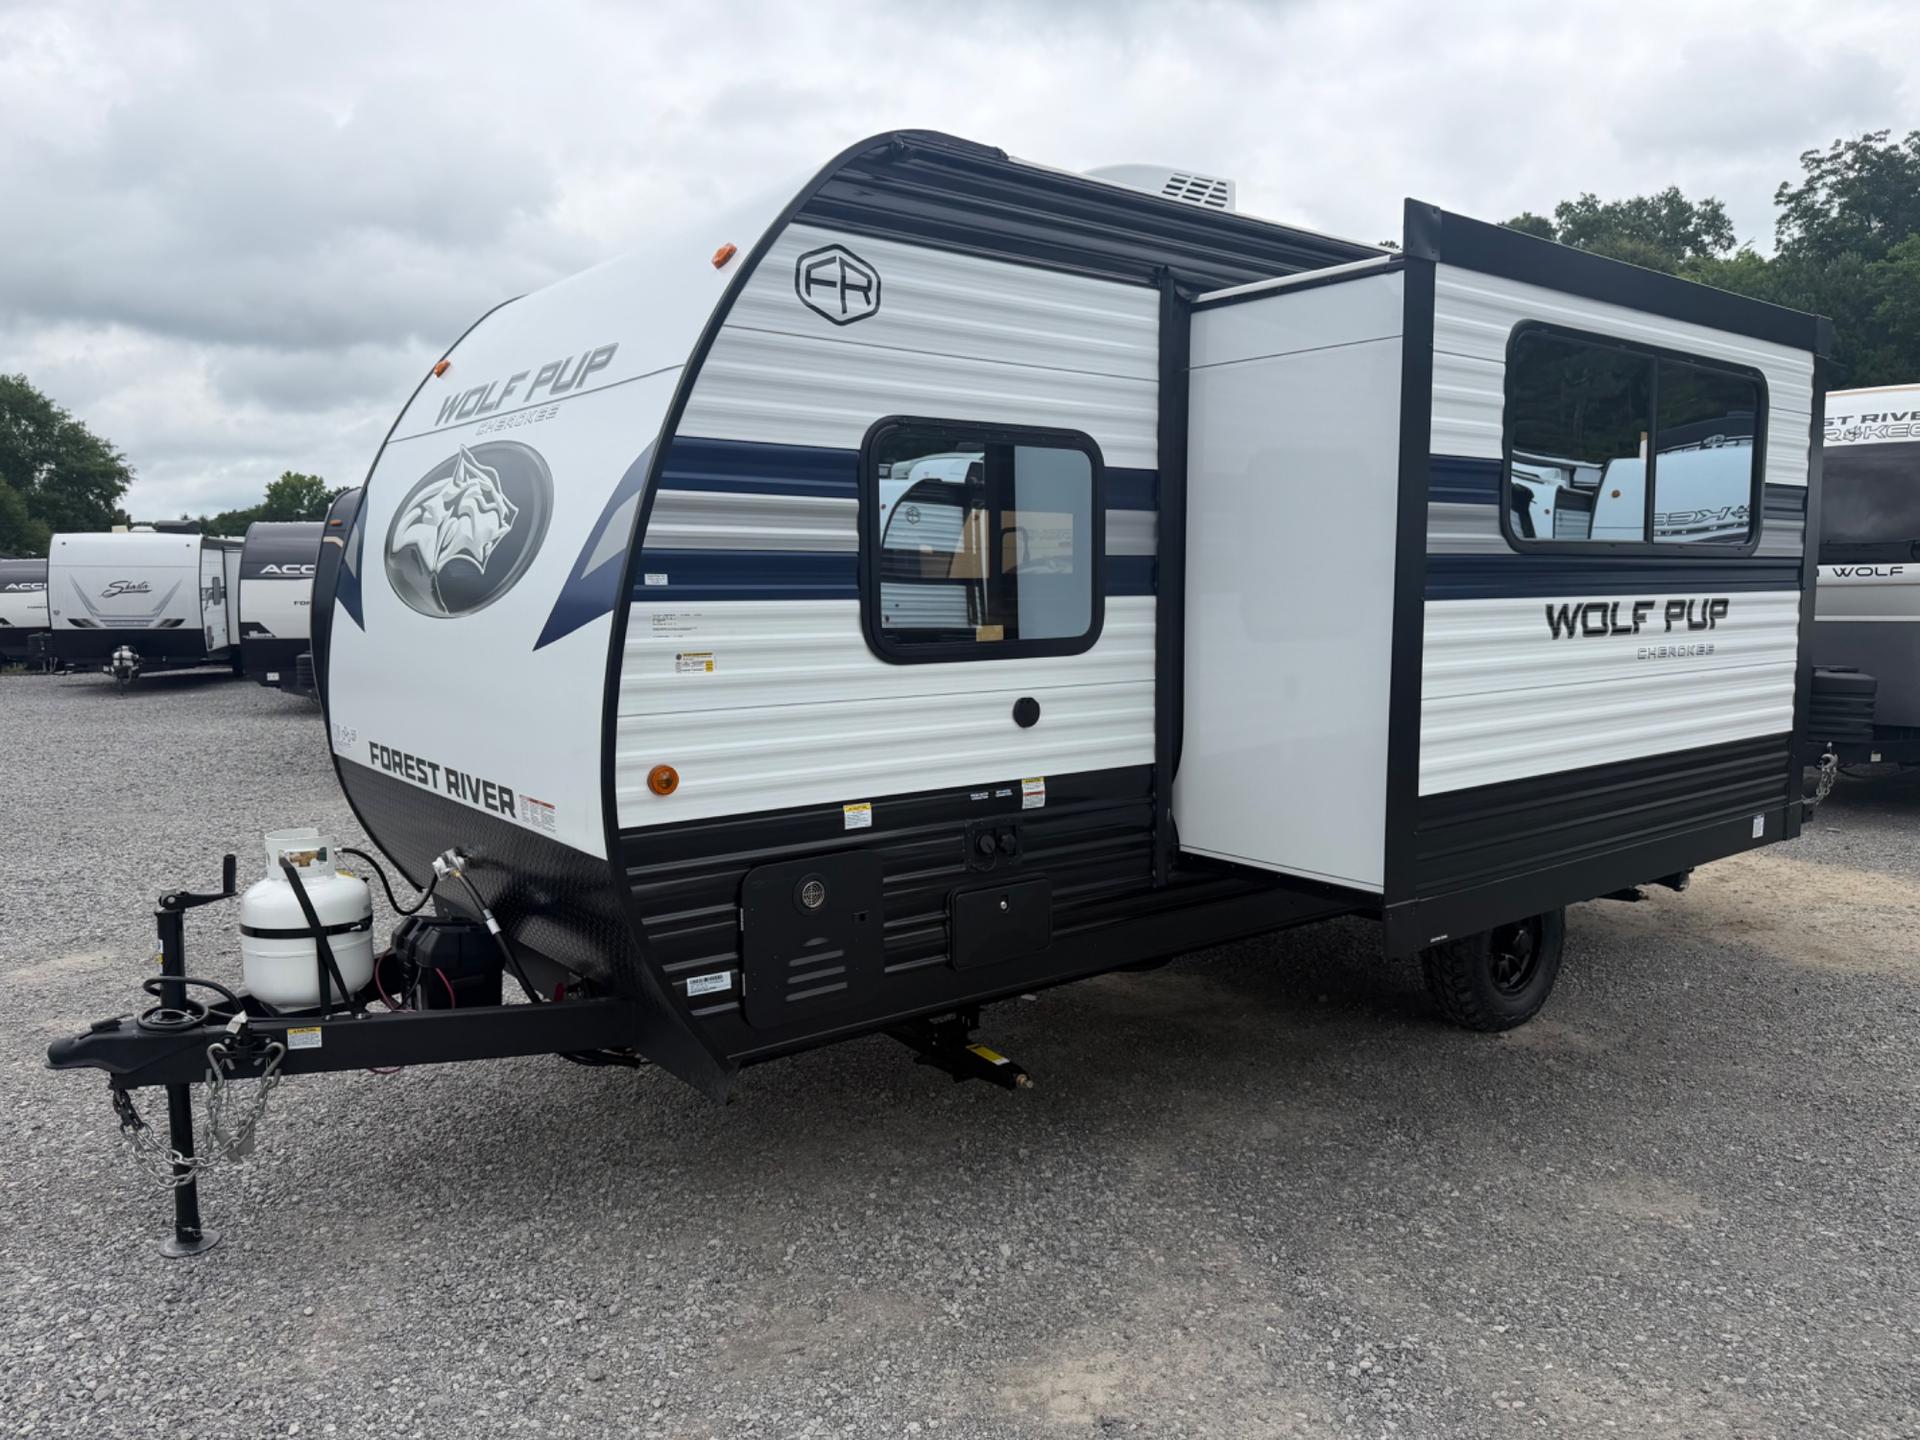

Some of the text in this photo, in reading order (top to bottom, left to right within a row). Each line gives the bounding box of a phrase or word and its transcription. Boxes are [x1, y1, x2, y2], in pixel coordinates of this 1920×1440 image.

[804, 255, 873, 315] FR
[434, 342, 619, 427] WOLF PUP
[475, 404, 560, 436] CHEROKEE
[1832, 566, 1904, 578] WOLF
[1545, 598, 1729, 640] WOLF PUP
[1636, 643, 1715, 660] CHEROKEE
[367, 741, 440, 789] FOREST
[444, 767, 517, 819] RIVER
